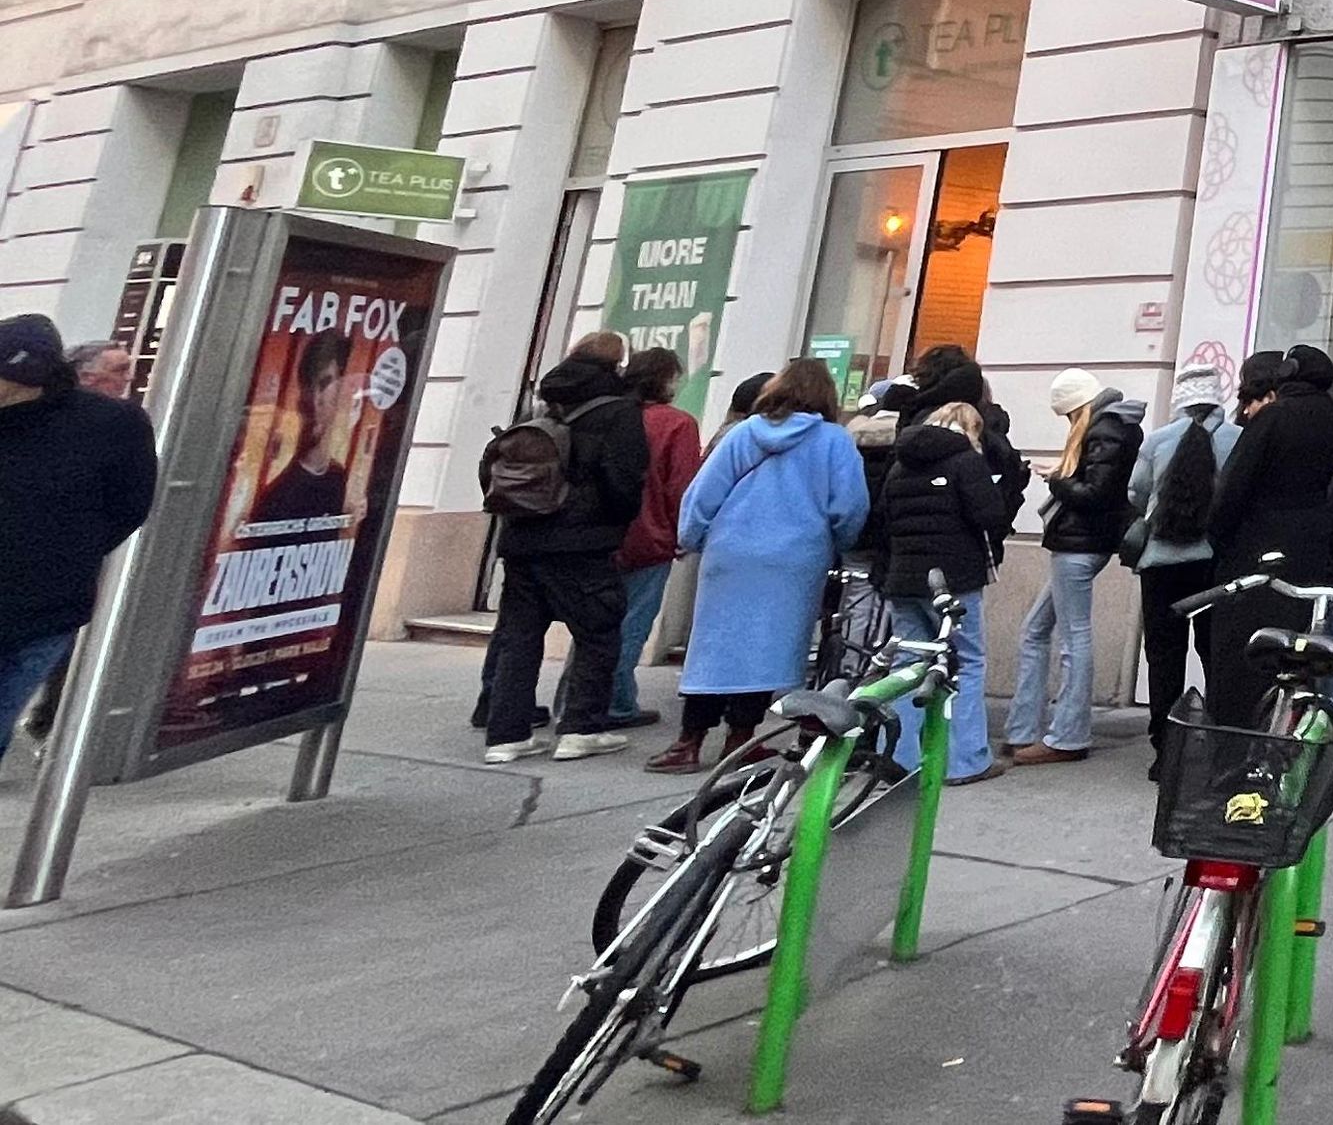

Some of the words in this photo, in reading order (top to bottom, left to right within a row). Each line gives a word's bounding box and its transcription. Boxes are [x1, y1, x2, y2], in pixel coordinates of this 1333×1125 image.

[368, 170, 404, 186] TEA
[409, 175, 455, 191] PLUS
[637, 236, 708, 269] MORE
[631, 280, 698, 311] THAN
[272, 286, 340, 334] FAB
[344, 295, 407, 343] FOX
[201, 537, 355, 616] ZAUBERSHOW
